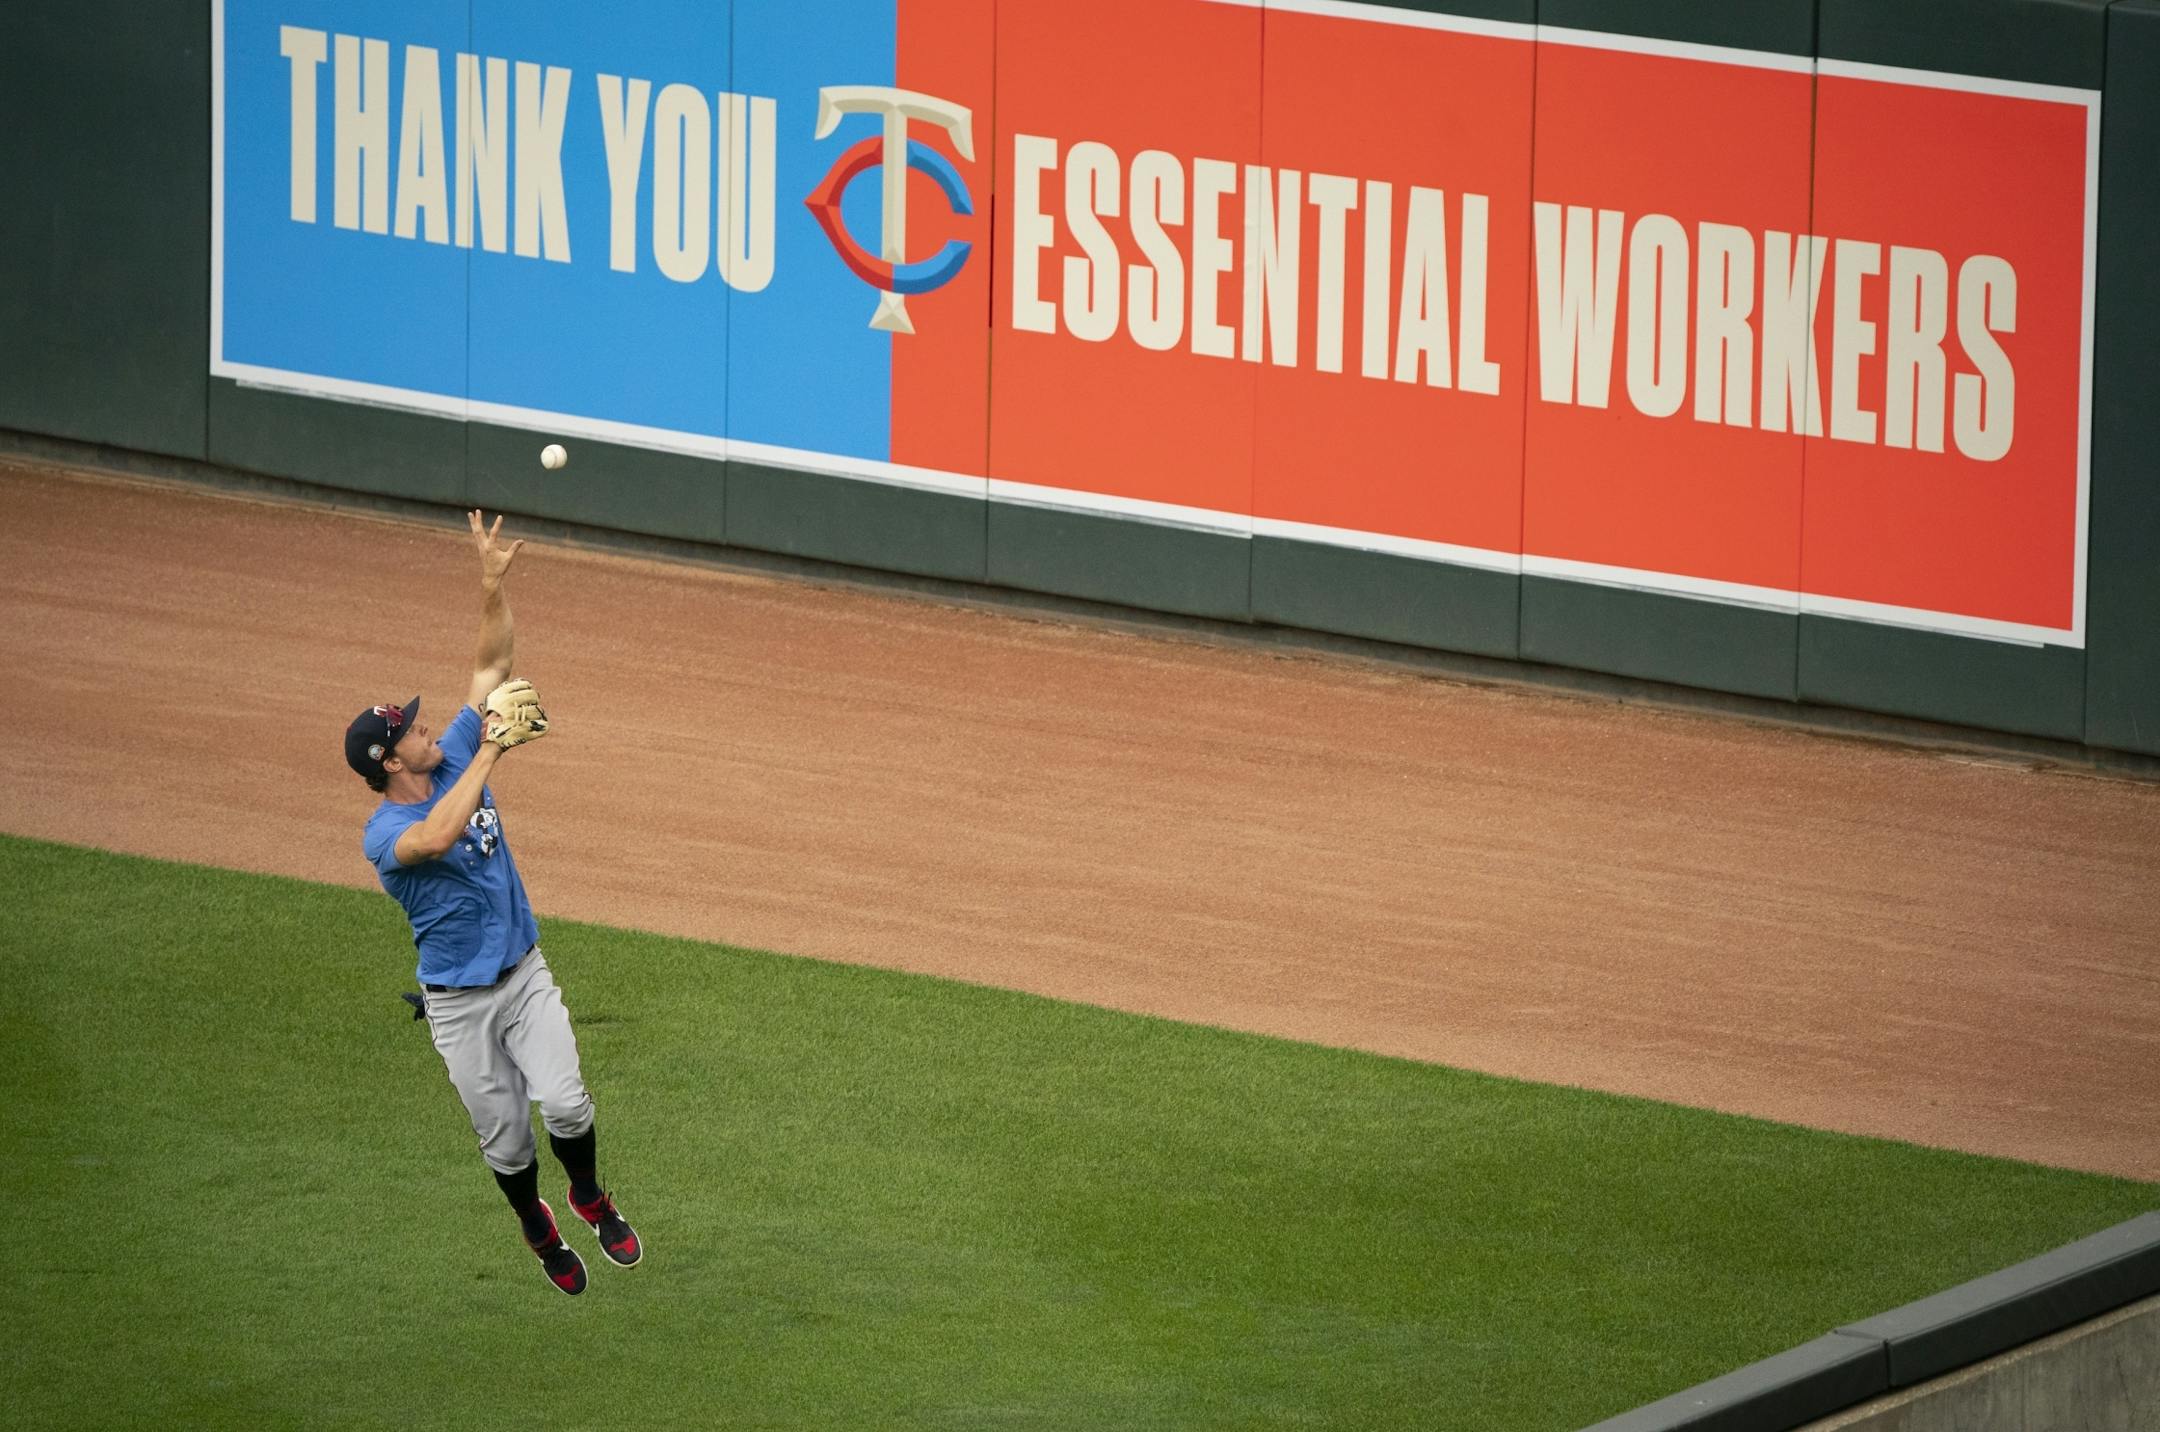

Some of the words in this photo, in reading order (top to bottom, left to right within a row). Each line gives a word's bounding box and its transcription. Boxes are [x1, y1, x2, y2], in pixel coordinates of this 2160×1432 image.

[280, 25, 572, 263] THANK
[597, 73, 777, 293] YOU
[1012, 133, 1501, 396] ESSENTIAL
[1533, 201, 2018, 462] WORKERS
